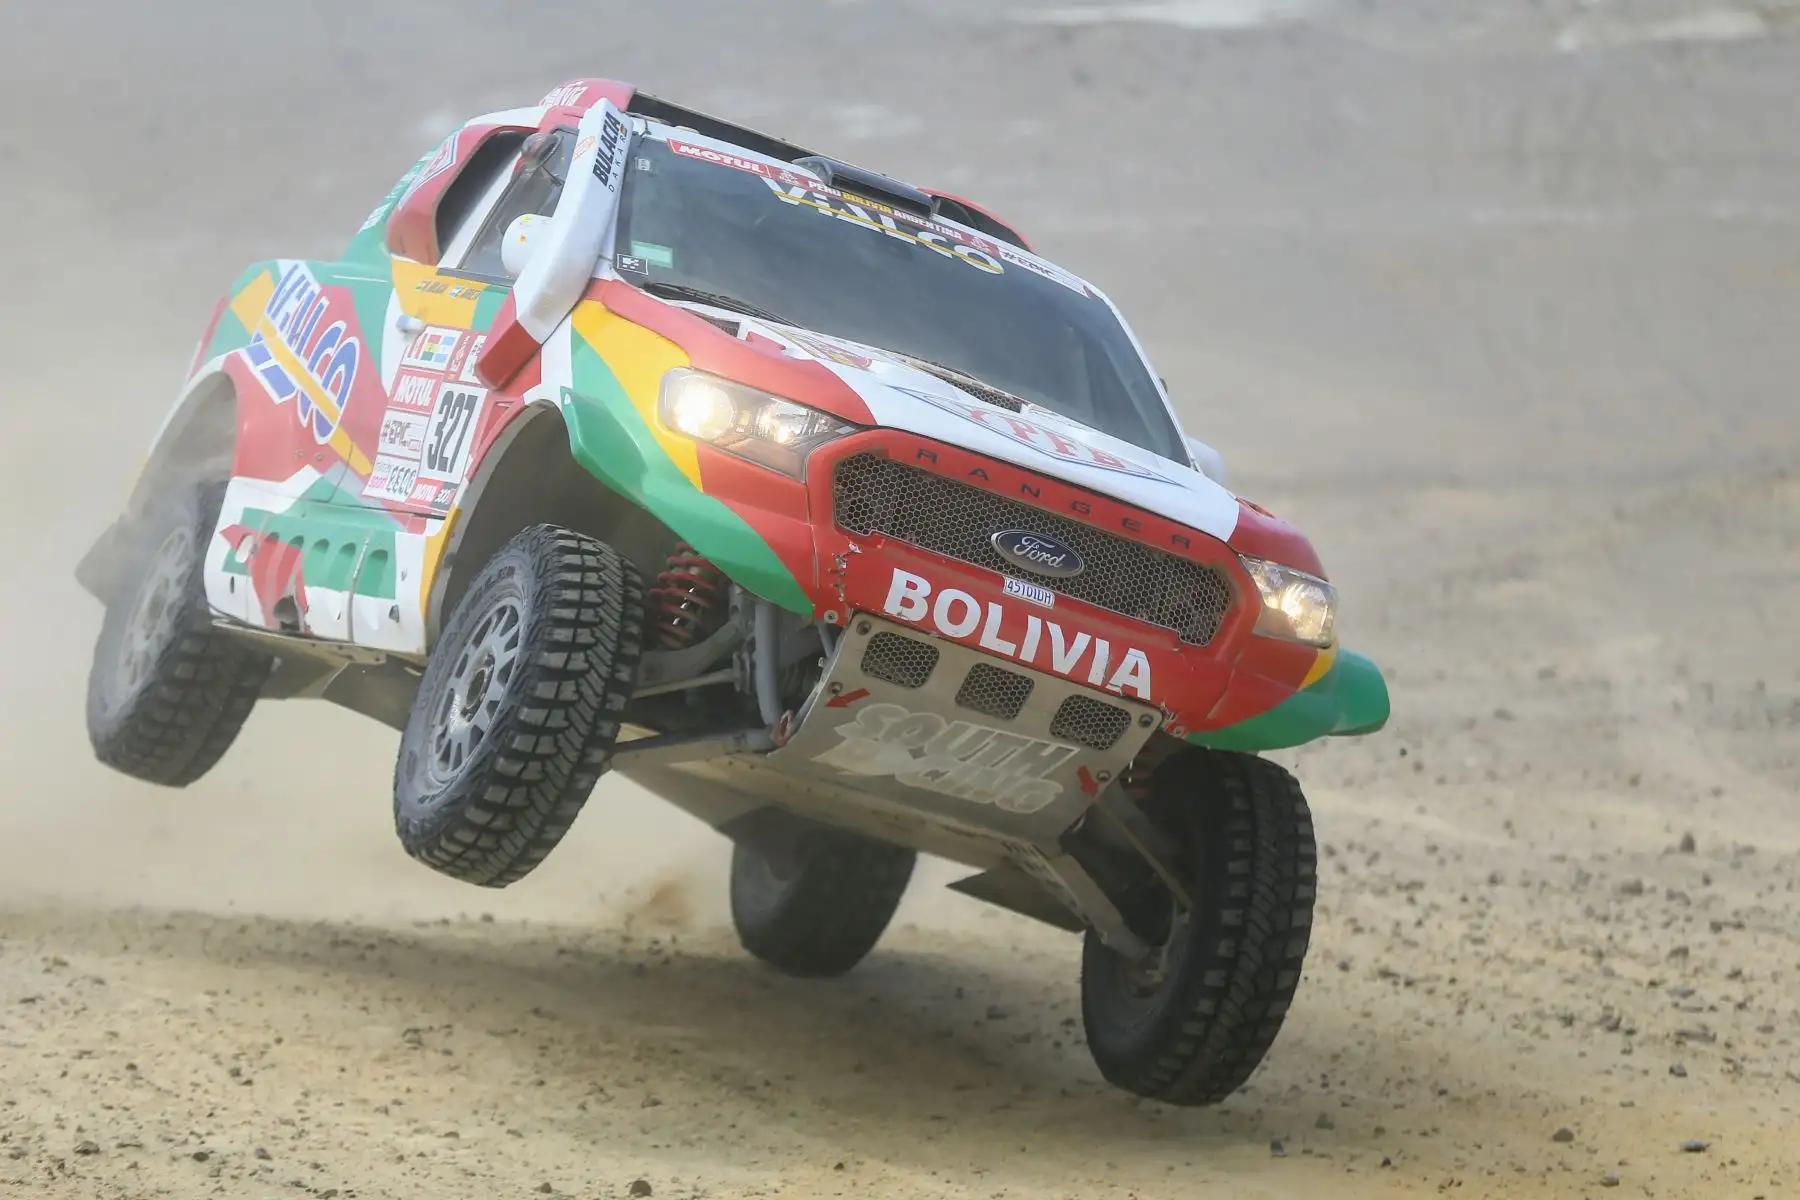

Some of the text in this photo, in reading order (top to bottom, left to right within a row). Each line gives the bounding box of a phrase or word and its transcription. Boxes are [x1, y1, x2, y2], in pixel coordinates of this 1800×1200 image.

[592, 111, 621, 188] BULACIA
[608, 135, 627, 193] DAKAR
[678, 144, 765, 176] MOTUL
[893, 209, 963, 241] ARGENTINA
[393, 373, 437, 408] MOTUL
[427, 390, 478, 474] 327
[916, 448, 1192, 550] RANGER
[1013, 536, 1066, 568] Ford
[884, 567, 1150, 702] BOLIVIA
[834, 703, 1080, 778] SOUTH
